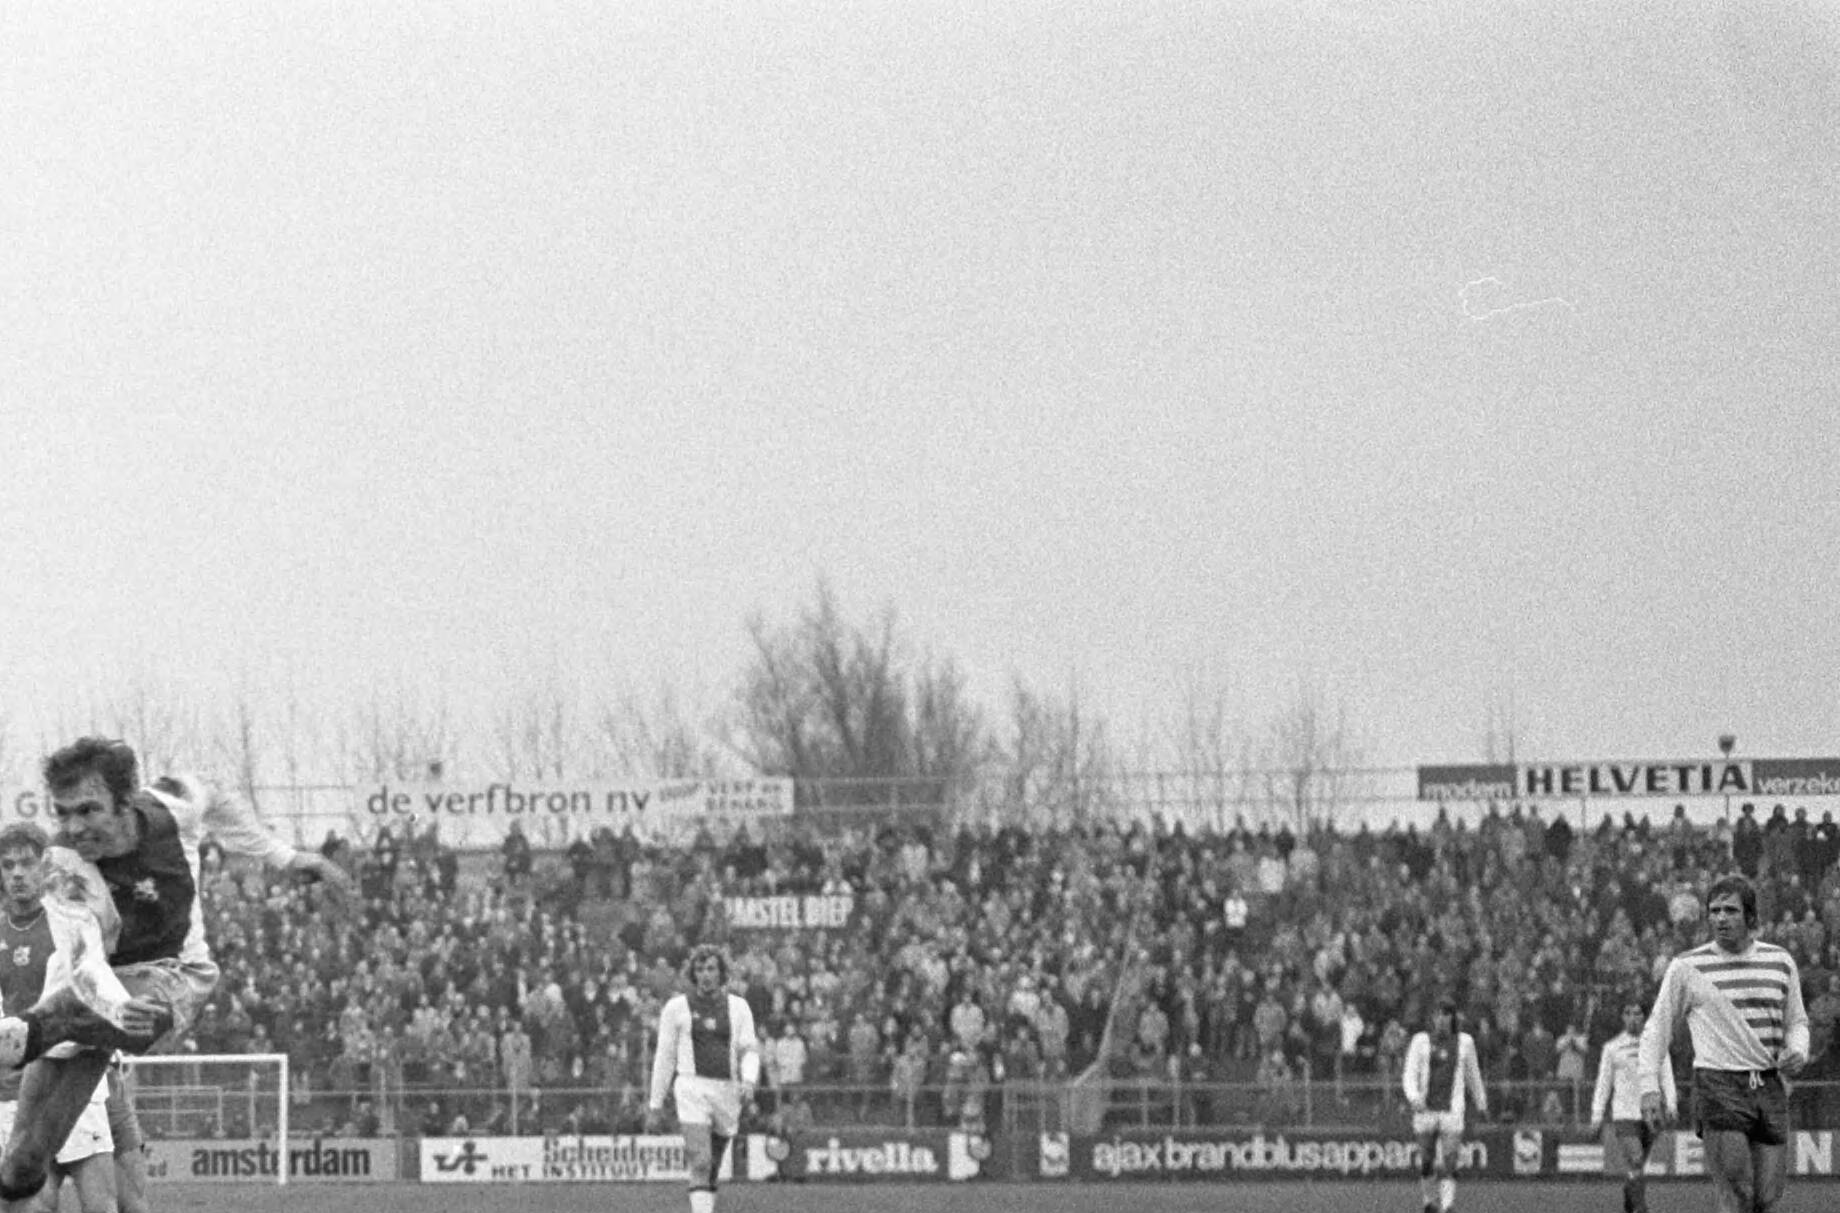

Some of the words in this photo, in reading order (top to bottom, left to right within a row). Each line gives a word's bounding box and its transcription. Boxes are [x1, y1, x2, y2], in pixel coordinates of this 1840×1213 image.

[1526, 764, 1748, 793] HELVETIA
[367, 785, 411, 814] de
[424, 783, 591, 814] verfbron
[606, 789, 650, 812] nv
[544, 1136, 687, 1170] Scheidegg
[807, 1138, 939, 1174] rivella
[1093, 1135, 1161, 1177] ajax
